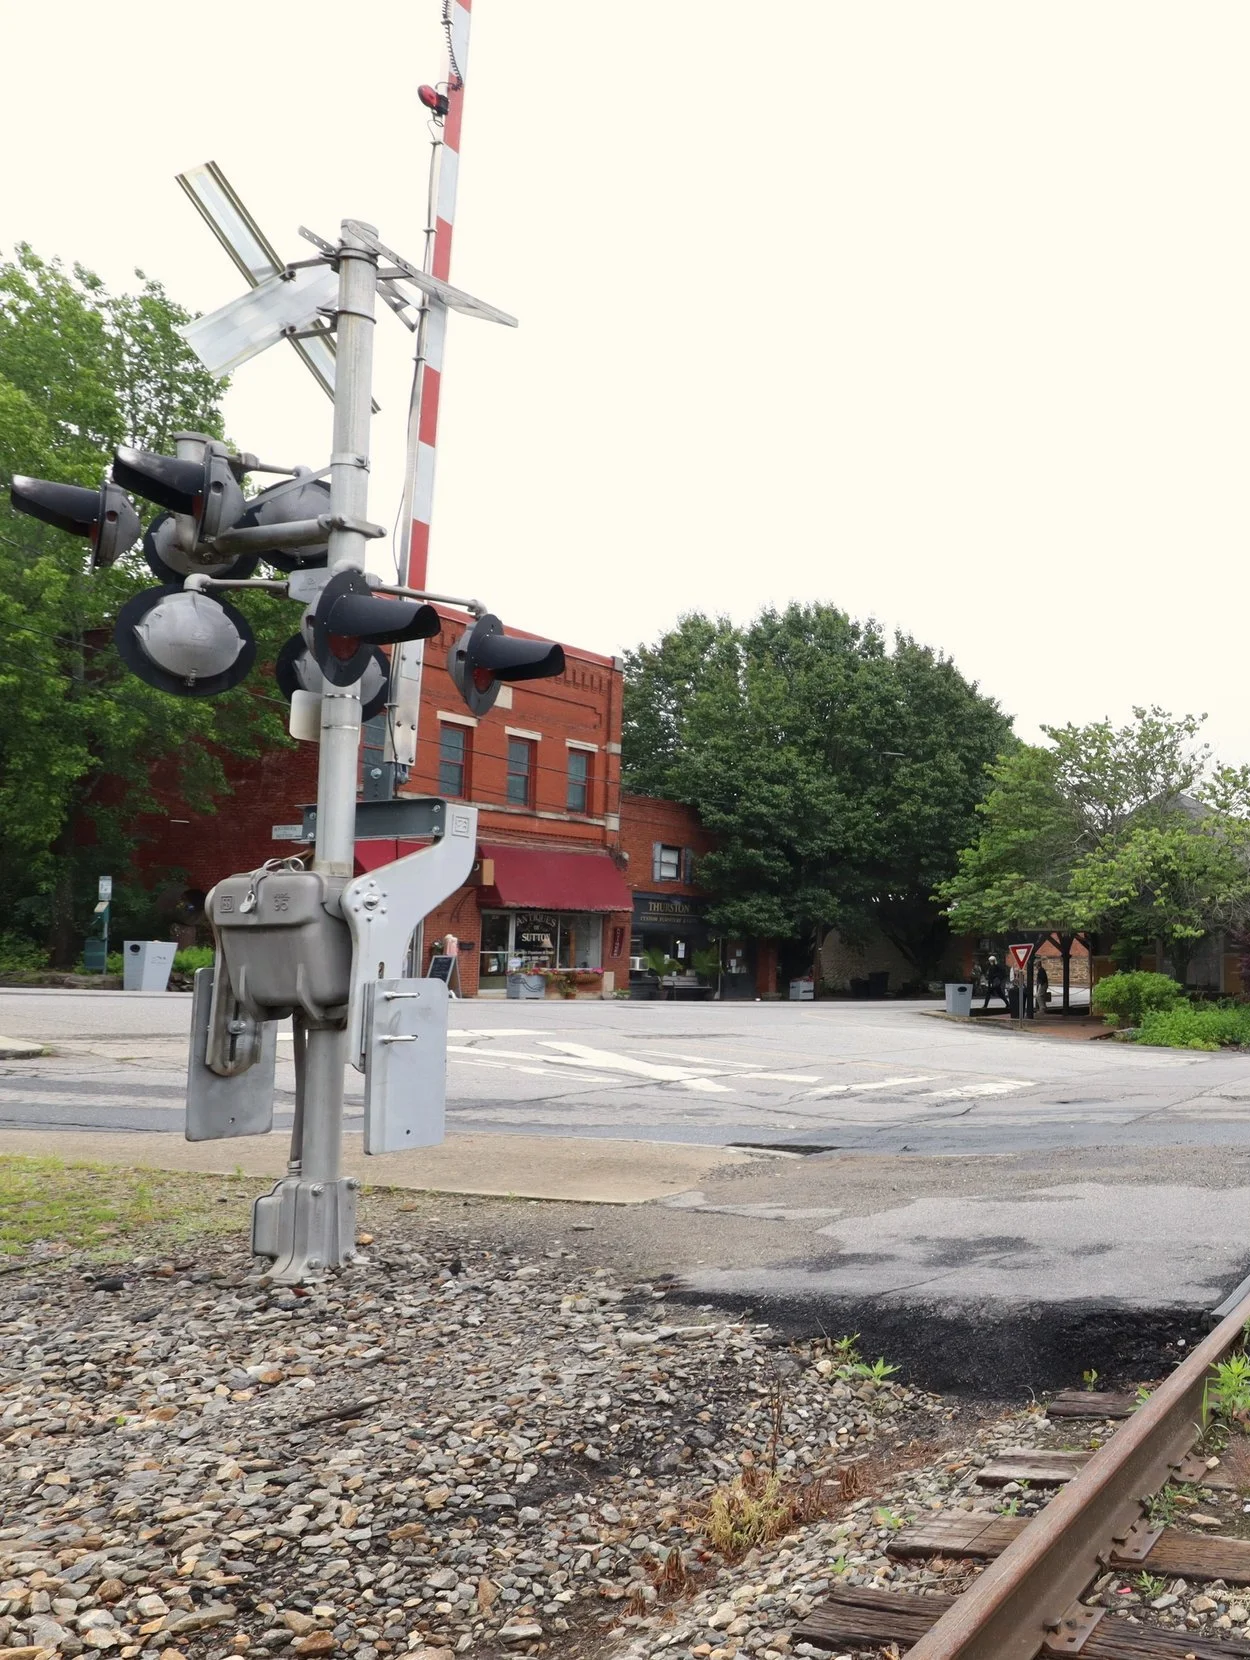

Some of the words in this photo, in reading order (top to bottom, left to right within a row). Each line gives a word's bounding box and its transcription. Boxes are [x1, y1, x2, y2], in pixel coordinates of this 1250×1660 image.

[648, 901, 690, 913] THURSTON
[516, 911, 557, 928] ANTIQUES
[521, 932, 551, 942] SUTTON
